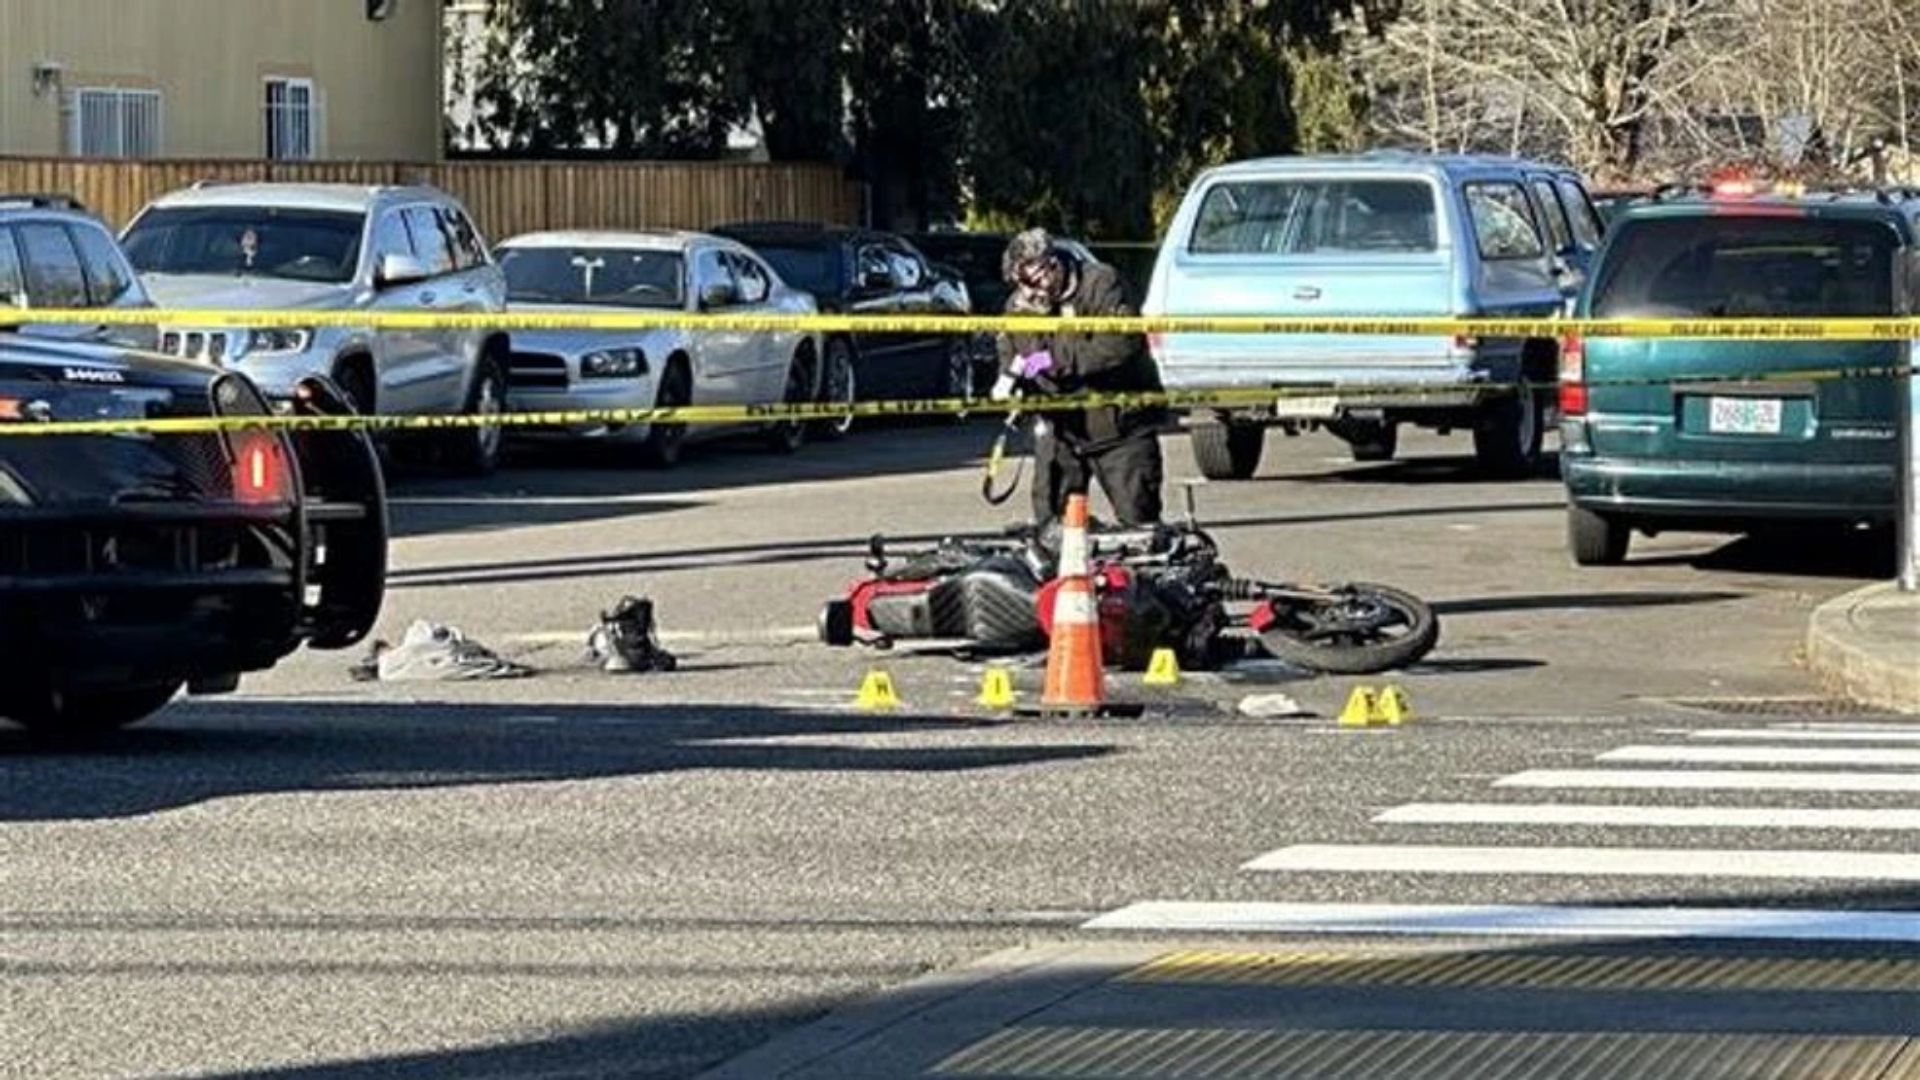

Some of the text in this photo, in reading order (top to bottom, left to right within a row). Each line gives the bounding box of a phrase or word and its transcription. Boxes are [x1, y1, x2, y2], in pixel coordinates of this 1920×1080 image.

[1670, 323, 1708, 336] POLICE
[1738, 323, 1755, 336] DO
[1760, 323, 1781, 336] NOT
[1784, 323, 1823, 336] CROSS
[1872, 324, 1911, 337] POLICE
